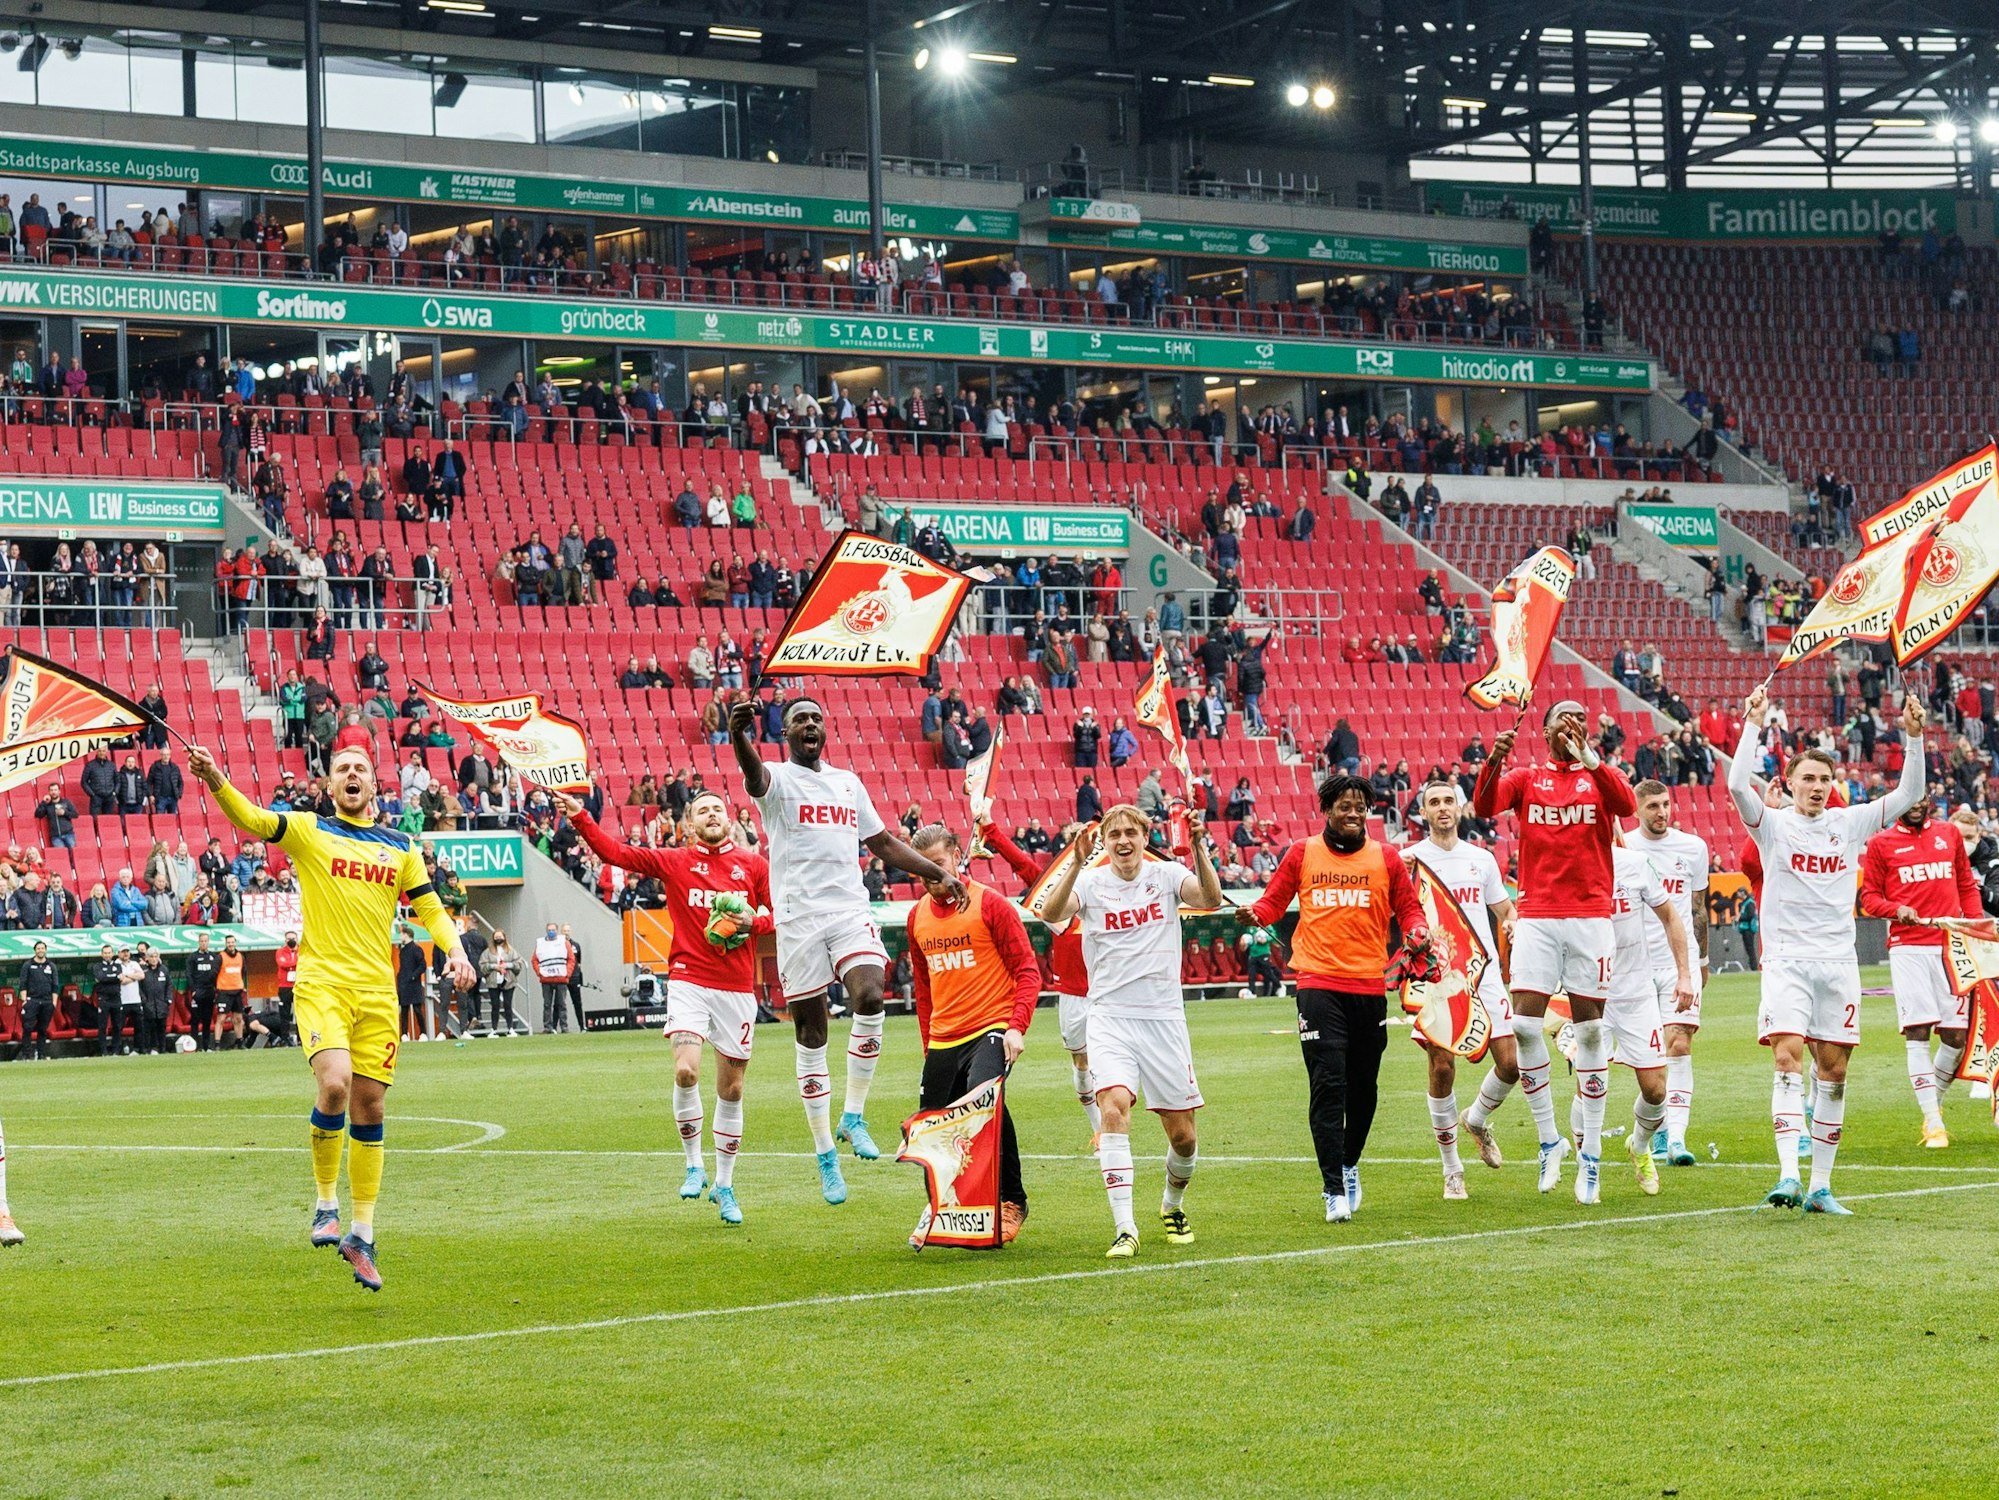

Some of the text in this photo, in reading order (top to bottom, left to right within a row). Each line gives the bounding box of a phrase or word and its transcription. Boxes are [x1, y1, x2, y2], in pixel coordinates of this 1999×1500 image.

[0, 151, 200, 183] Stadtsparkasse Augsburg
[322, 168, 373, 189] Audi
[451, 174, 517, 189] KASTNER
[704, 197, 803, 218] Abenstein
[833, 206, 908, 228] aumller
[1707, 199, 1938, 232] Familienblock
[1428, 251, 1500, 271] TIERHOLD
[47, 283, 217, 313] VERSICHERUNGEN
[257, 291, 346, 321] Sortimo
[444, 305, 493, 328] swa
[561, 307, 646, 333] grünbeck
[829, 323, 935, 342] STADLER
[1356, 349, 1395, 367] PCI
[89, 492, 123, 520] LEW
[128, 500, 219, 517] Business Club
[942, 514, 1012, 541] ARENA
[1023, 516, 1049, 541] LEW
[1053, 523, 1123, 538] Business Club
[1150, 554, 1168, 587] G
[1725, 553, 1744, 584] H
[799, 804, 858, 828] REWE
[1528, 804, 1597, 826] REWE
[437, 843, 518, 872] ARENA
[1791, 853, 1848, 874] REWE
[331, 857, 397, 887] REWE
[1312, 871, 1369, 887] uhlsport
[1898, 861, 1953, 884] REWE
[1311, 889, 1371, 908] REWE
[1452, 887, 1480, 904] WE
[1105, 902, 1164, 931] REWE
[921, 933, 971, 951] uhlsport
[1300, 1031, 1320, 1041] EWE
